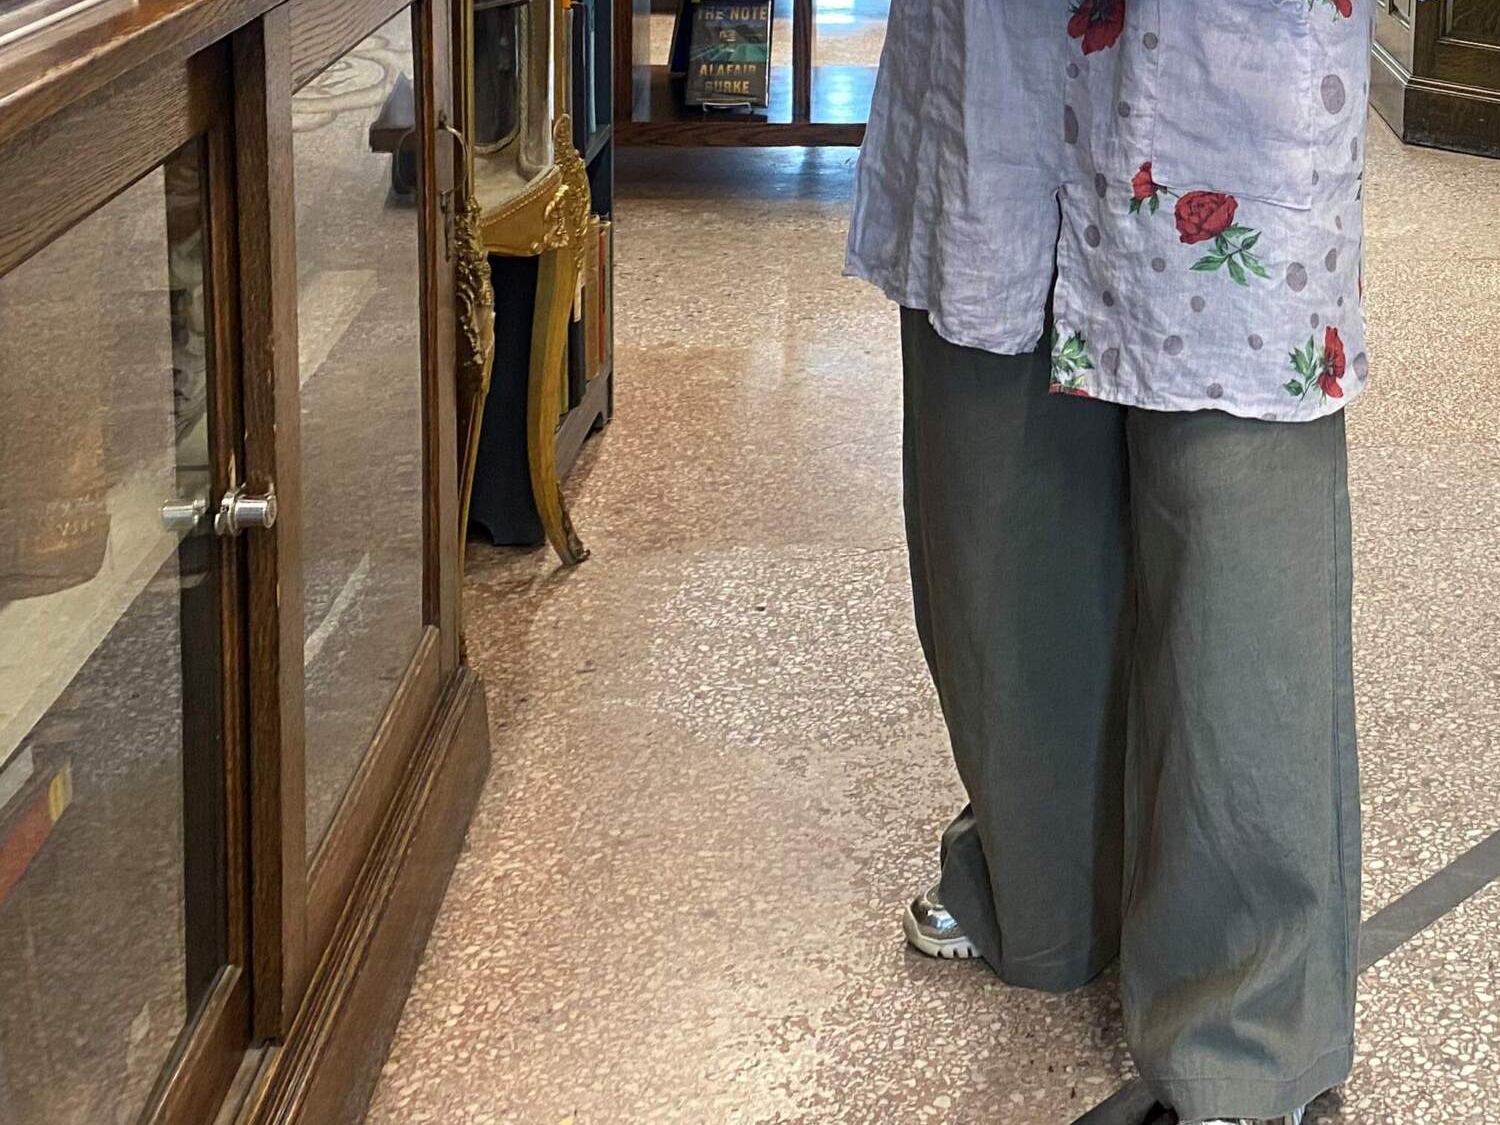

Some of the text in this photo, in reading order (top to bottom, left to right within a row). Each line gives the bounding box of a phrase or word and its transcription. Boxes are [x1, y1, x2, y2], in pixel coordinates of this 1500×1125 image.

[729, 5, 768, 20] NOTE
[700, 63, 757, 76] ALAFAIR
[704, 80, 751, 94] BURKE
